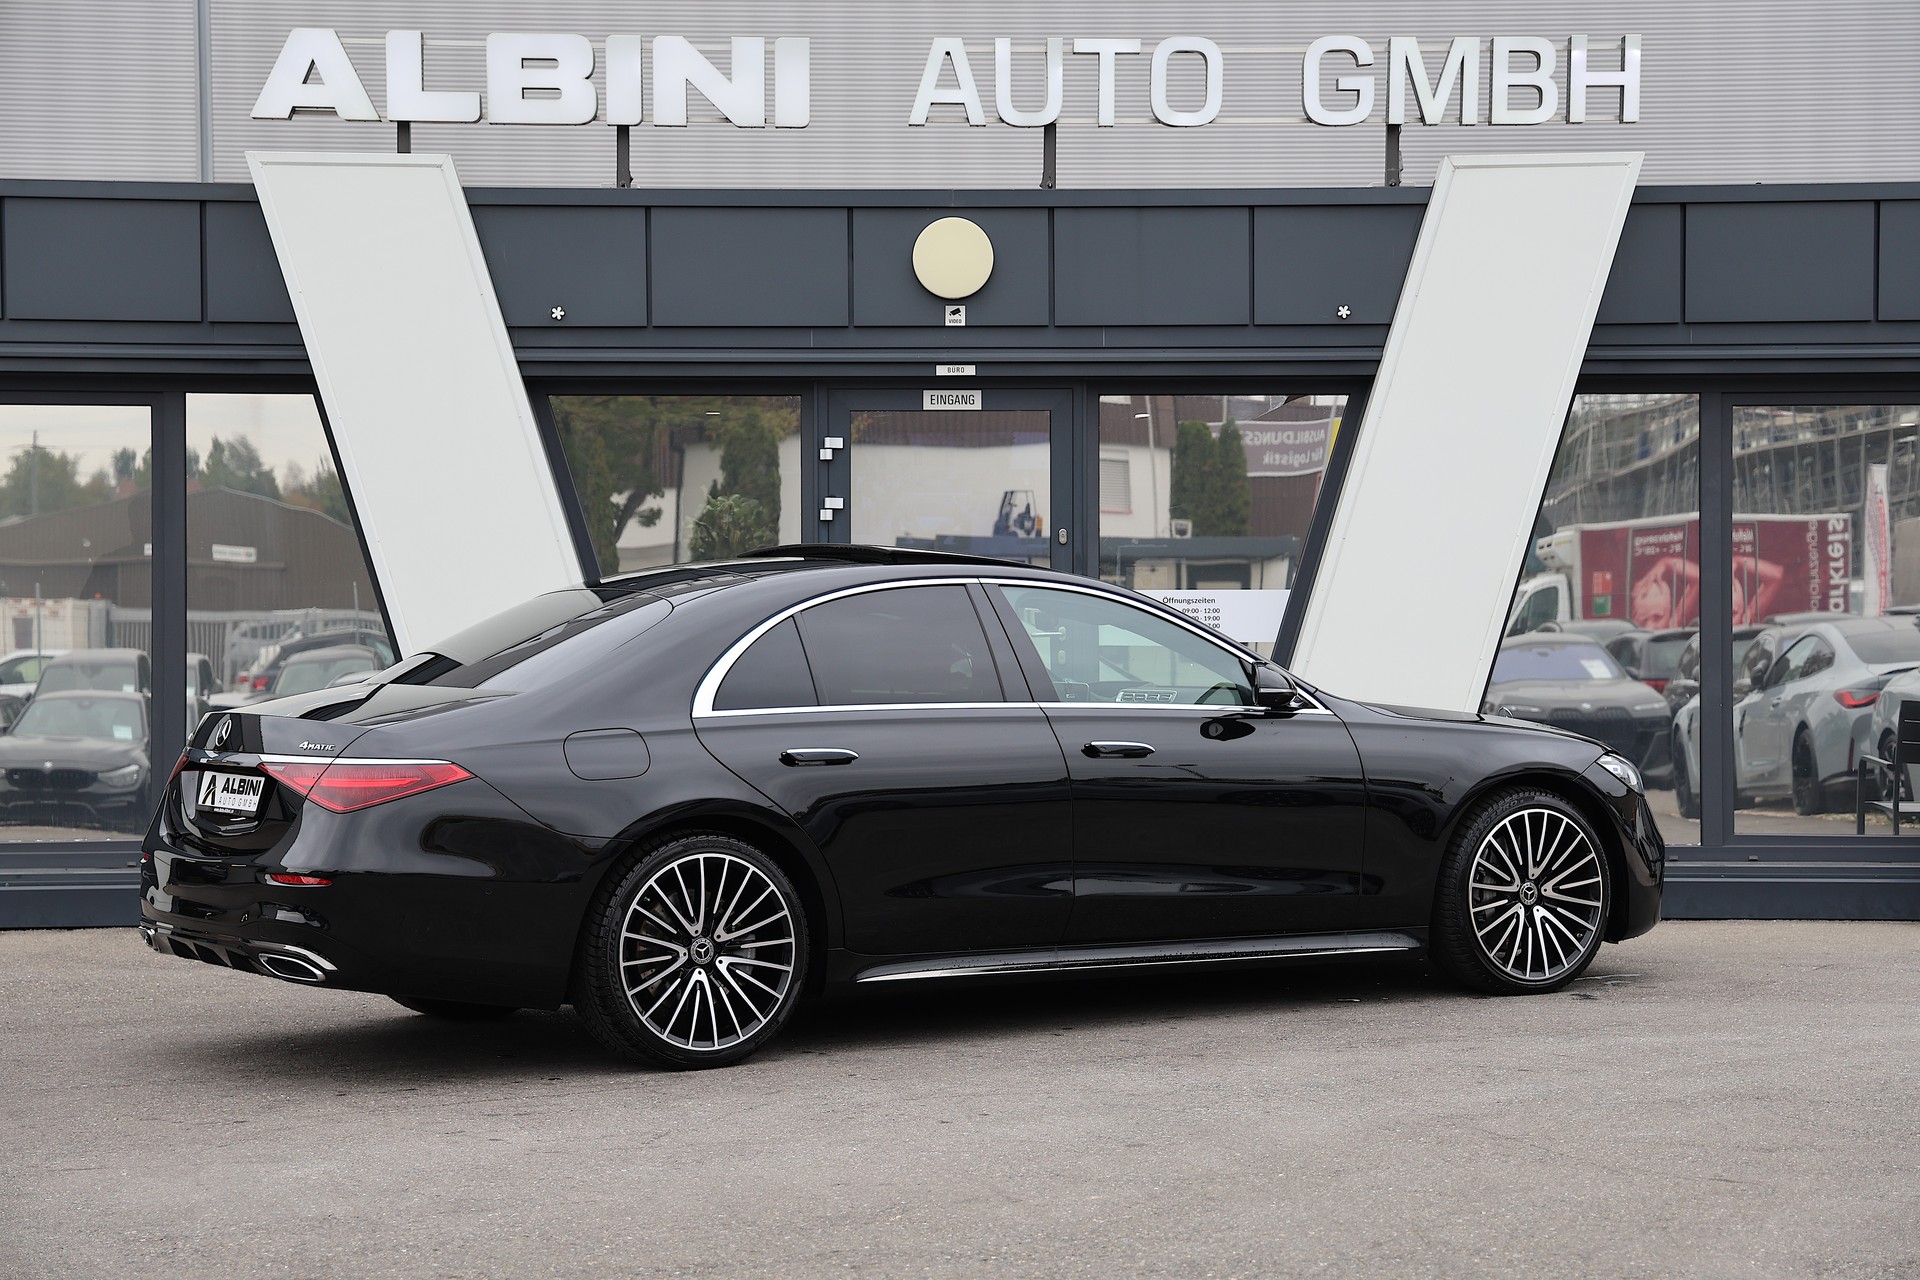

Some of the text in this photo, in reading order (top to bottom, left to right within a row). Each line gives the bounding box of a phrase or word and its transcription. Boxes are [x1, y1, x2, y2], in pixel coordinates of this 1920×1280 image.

[251, 28, 1641, 128] ALBINI AUTO GMBH
[947, 365, 965, 373] BÜRO
[930, 394, 975, 405] EINGANG
[1163, 596, 1216, 605] Öffnungszeiten
[299, 740, 336, 751] 4MATIC
[221, 777, 262, 796] ALBINI
[218, 796, 259, 808] AUTO GMBH
